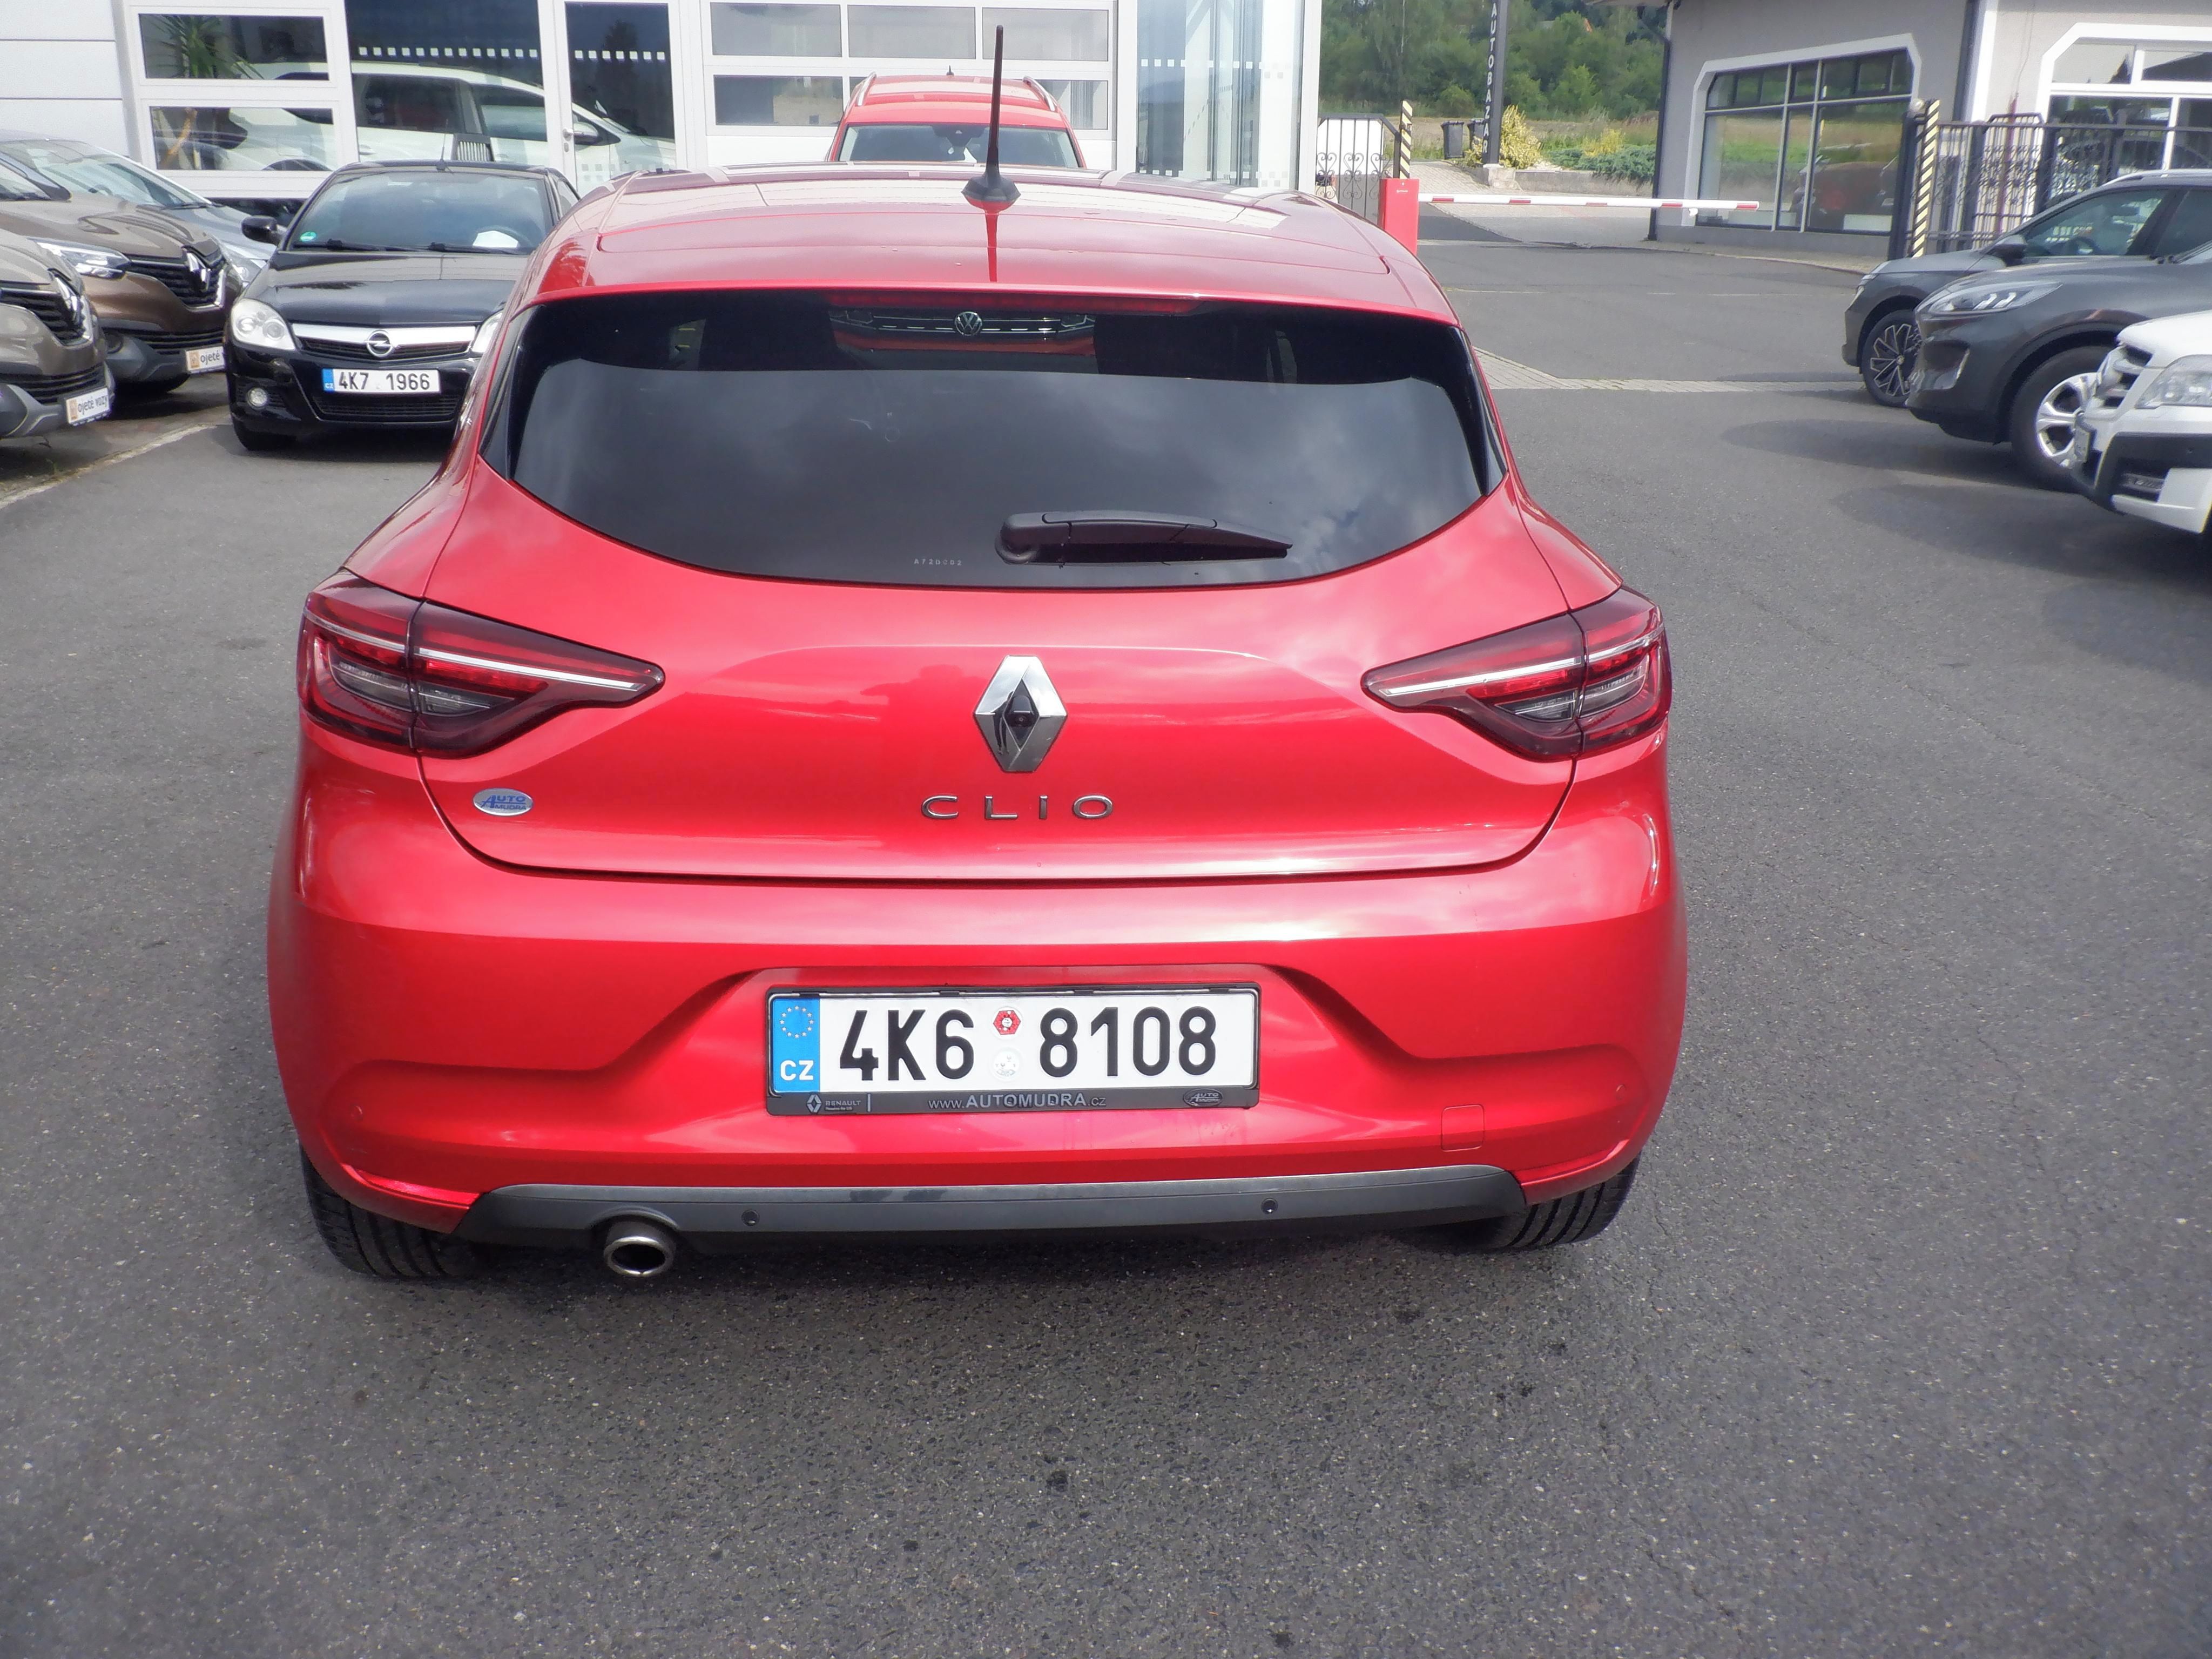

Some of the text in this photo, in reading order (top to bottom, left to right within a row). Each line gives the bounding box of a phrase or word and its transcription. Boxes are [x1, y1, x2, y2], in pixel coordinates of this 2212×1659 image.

[1483, 3, 1497, 153] AUTOBAZAR
[200, 350, 220, 365] ojeté
[339, 372, 369, 389] 4K7
[386, 373, 430, 390] 1966
[480, 794, 527, 809] AUTO
[921, 794, 1114, 819] CLIO
[780, 1006, 1217, 1082] CZ 4K6 8108
